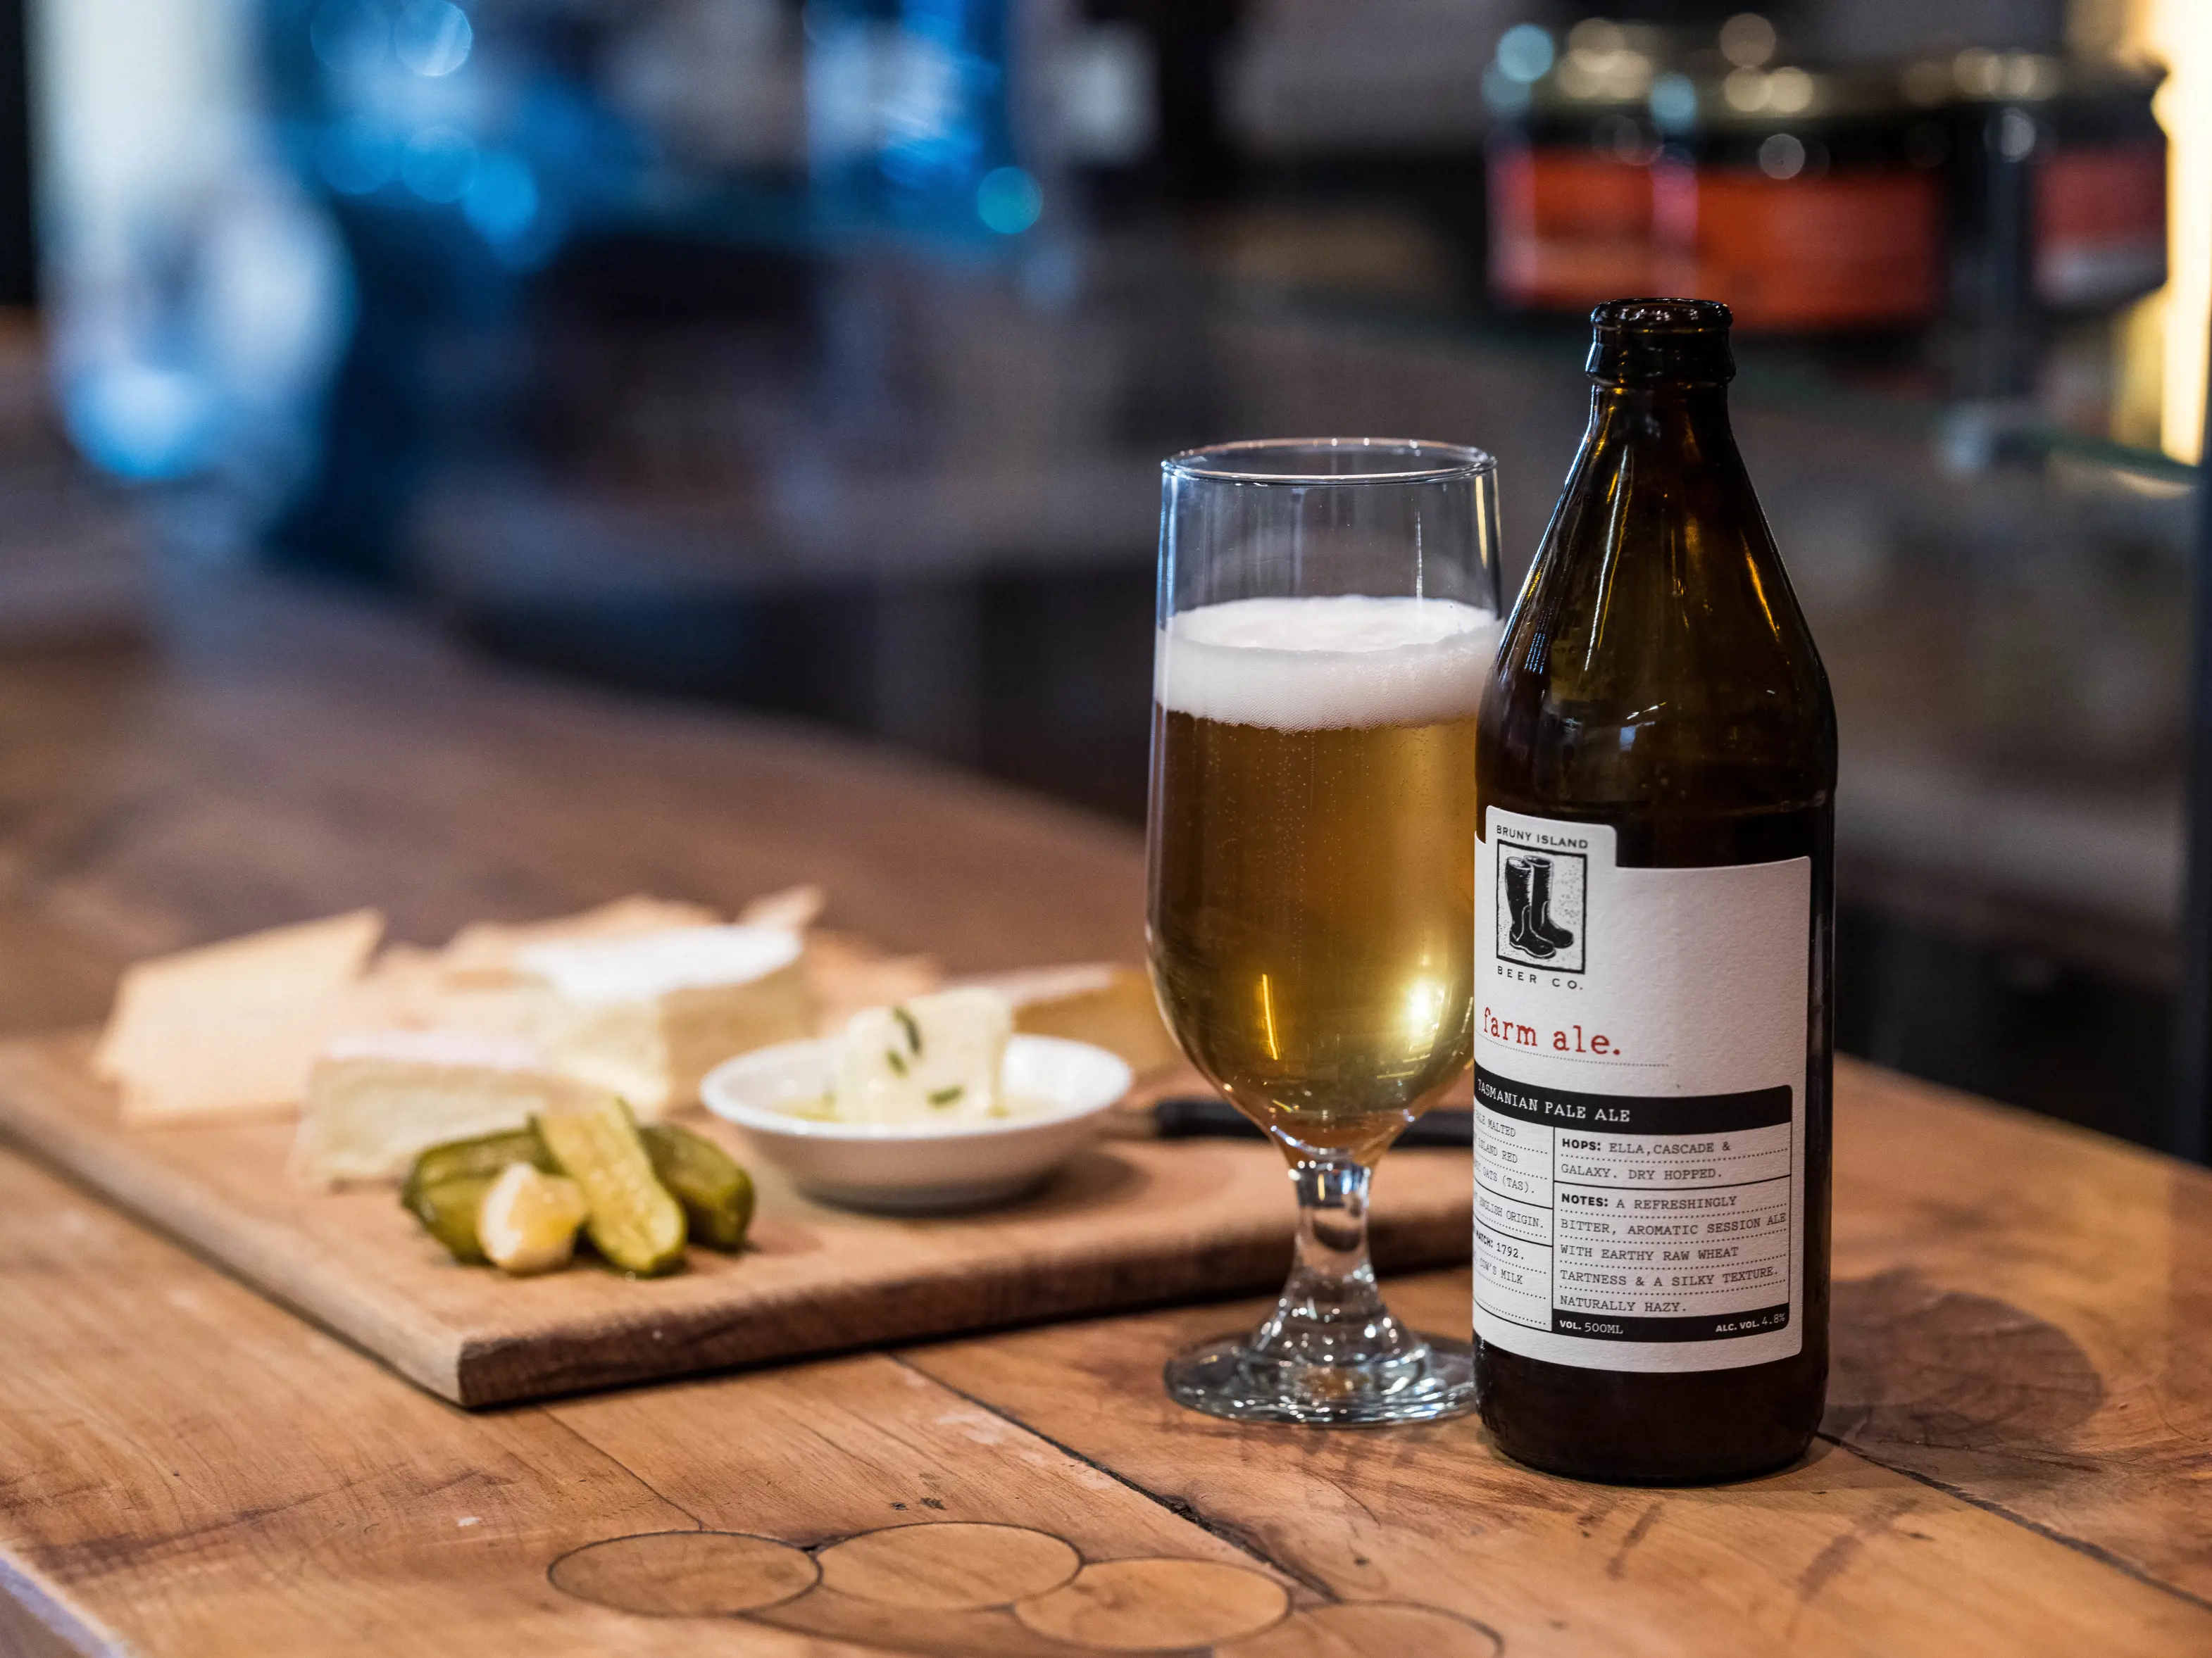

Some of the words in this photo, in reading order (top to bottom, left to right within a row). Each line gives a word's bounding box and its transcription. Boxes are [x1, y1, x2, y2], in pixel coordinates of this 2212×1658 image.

[1497, 825, 1532, 842] BRUNY
[1537, 835, 1588, 848] ISLAND
[1497, 966, 1537, 983] BEER
[1552, 979, 1582, 990] CO.
[1484, 1007, 1537, 1046] farm
[1554, 1025, 1620, 1055] ale.
[1477, 1078, 1539, 1112] TASMANIAN
[1545, 1102, 1585, 1118] PALE
[1595, 1109, 1630, 1122] ALE
[1489, 1119, 1516, 1137] MALTED
[1563, 1138, 1601, 1151] HOPS:
[1722, 1141, 1730, 1151] &
[1502, 1150, 1518, 1163] RED
[1561, 1164, 1617, 1178] GALAXY.
[1629, 1169, 1655, 1180] DRY
[1664, 1168, 1721, 1180] HOPPED.
[1503, 1174, 1535, 1193] (TAS).
[1562, 1193, 1608, 1207] NOTES:
[1616, 1198, 1625, 1208] A
[1635, 1195, 1738, 1210] REFRESHINGLY
[1506, 1210, 1543, 1229] ORIGIN.
[1561, 1219, 1616, 1236] BITTER,
[1627, 1224, 1699, 1236] AROMATIC
[1707, 1218, 1761, 1233] SESSION
[1766, 1213, 1786, 1225] ALE
[1496, 1243, 1523, 1260] 1792.
[1561, 1245, 1592, 1257] WITH
[1601, 1249, 1654, 1260] EARTHY
[1663, 1250, 1689, 1260] RAW
[1698, 1247, 1739, 1259] WHEAT
[1501, 1269, 1523, 1284] MILK
[1560, 1269, 1626, 1286] TARTNESS
[1636, 1276, 1644, 1286] &
[1654, 1276, 1663, 1286] A
[1672, 1273, 1715, 1286] SILKY
[1723, 1267, 1778, 1283] TEXTURE.
[1561, 1295, 1636, 1311] NATURALLY
[1645, 1300, 1686, 1312] HAZY.
[1560, 1320, 1581, 1329] VOL.
[1585, 1322, 1623, 1333] 500ML
[1716, 1324, 1737, 1332] ALC.
[1762, 1313, 1785, 1325] 4.8%
